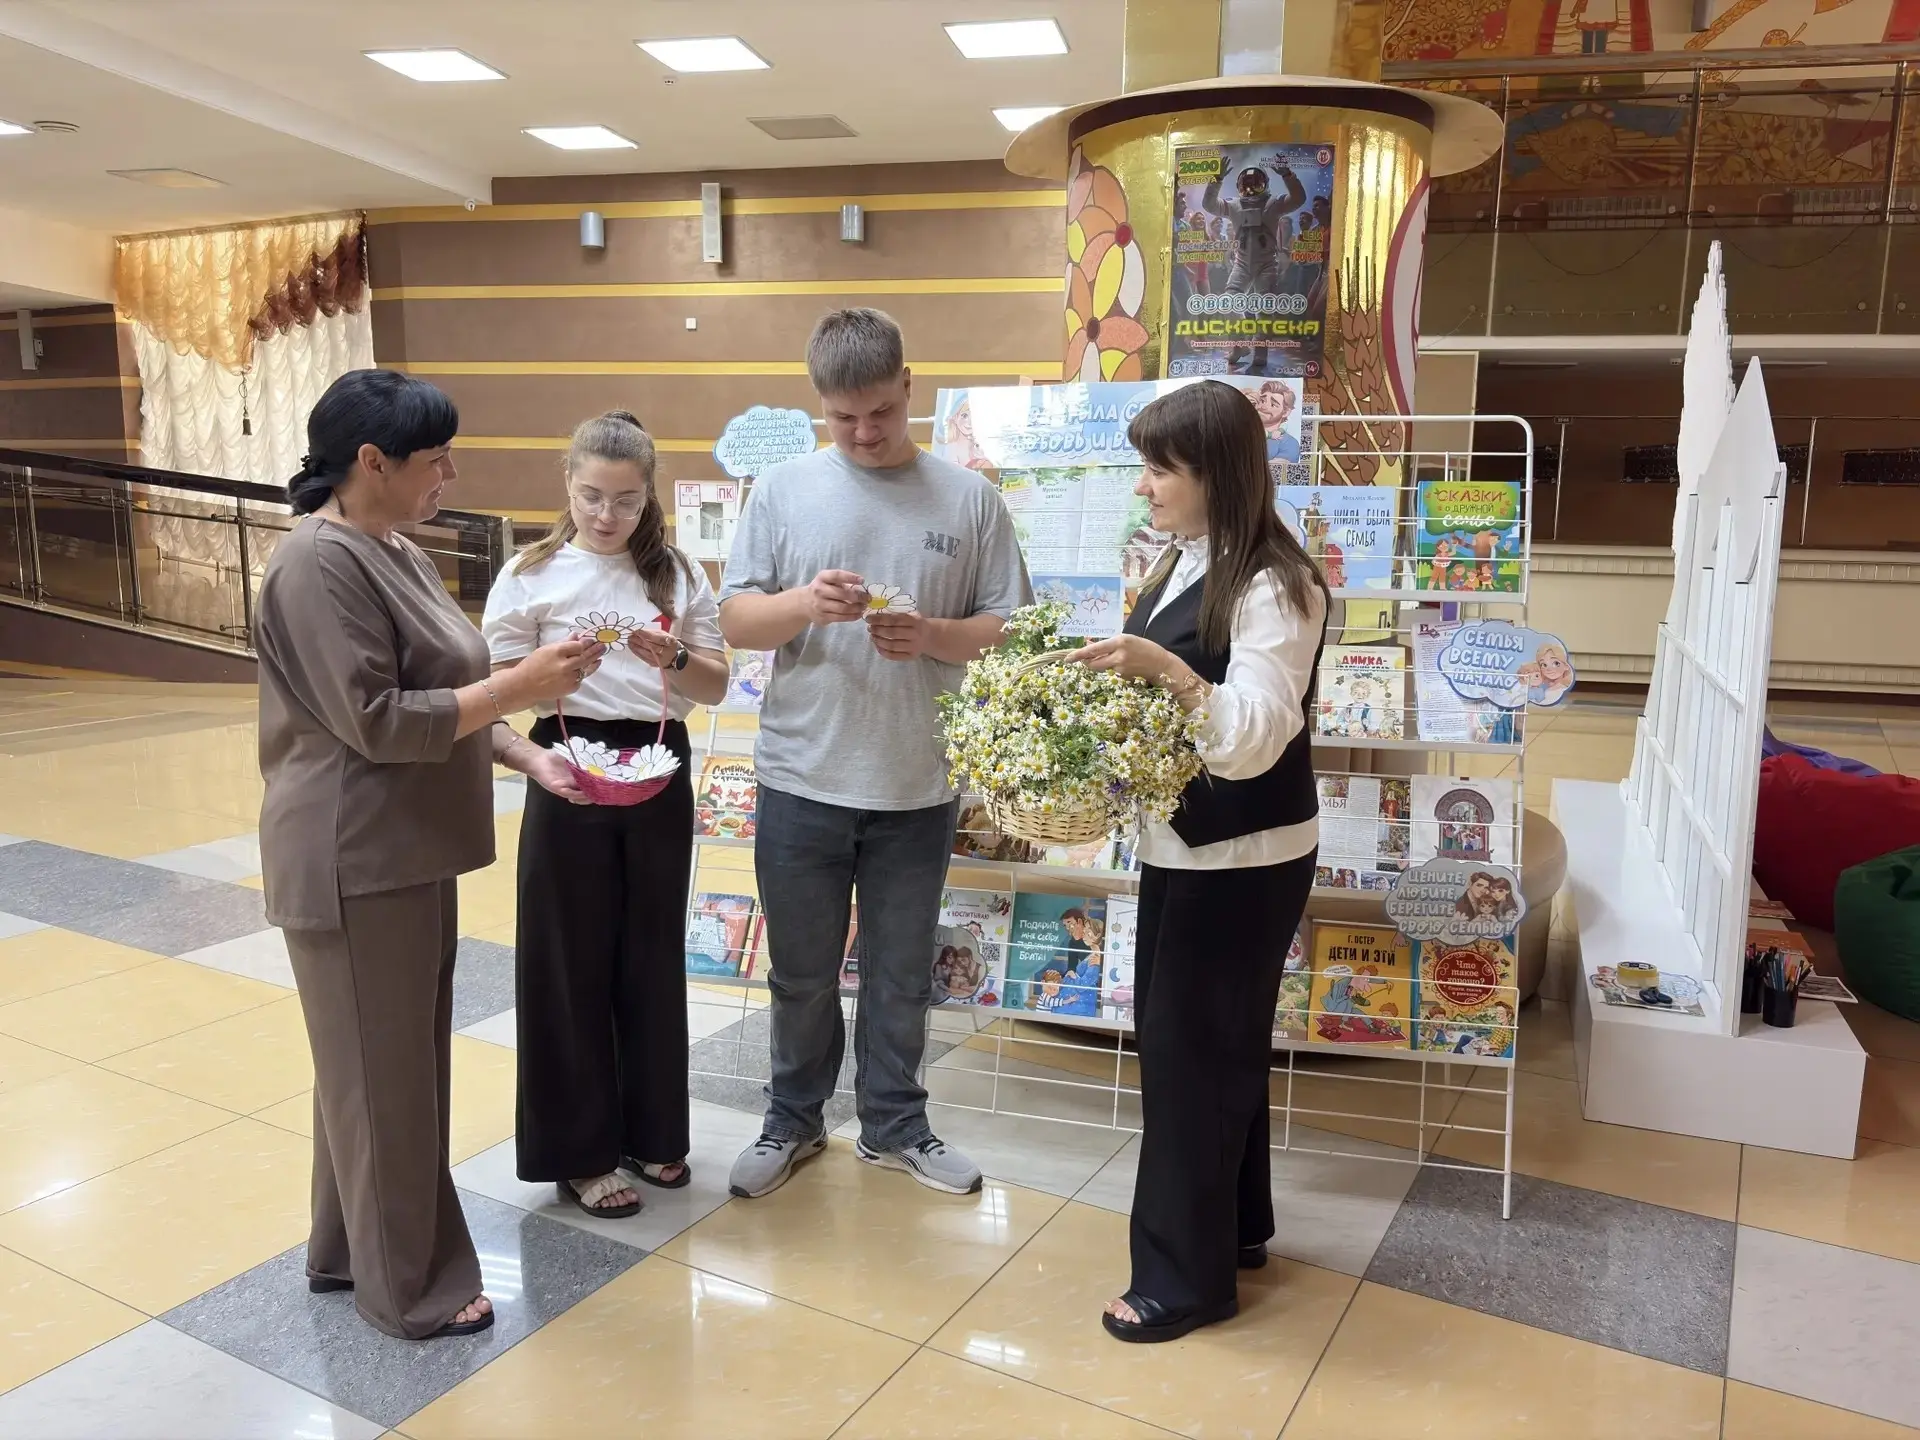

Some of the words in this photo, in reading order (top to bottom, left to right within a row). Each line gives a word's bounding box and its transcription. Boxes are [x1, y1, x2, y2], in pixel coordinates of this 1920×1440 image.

[1180, 148, 1220, 158] ПЯТНИЦА
[1179, 160, 1219, 174] 20:00
[1180, 176, 1217, 185] СУББОТА
[1175, 319, 1320, 336] ДИСКОТЕКА
[718, 487, 733, 500] ПК
[1436, 489, 1504, 502] СКАЗКИ
[1452, 503, 1494, 514] ДРУЖНОЙ
[1333, 509, 1360, 525] ЖИЛА
[1366, 509, 1390, 526] БЫЛА
[1346, 529, 1376, 547] СЕМЬЯ
[1463, 628, 1525, 652] СЕМЬЯ
[1449, 646, 1516, 671] ВСЕМУ
[1452, 668, 1519, 690] НАЧАЛО
[1321, 797, 1348, 809] МЬЯ
[1408, 870, 1466, 886] ЦЕНИТЕ,
[1389, 901, 1456, 917] БЕРЕГИТЕ
[1398, 920, 1445, 934] СВОЮ
[1448, 921, 1512, 936] СЕМЬЮ!
[1347, 935, 1353, 944] Г.
[1355, 935, 1376, 945] ОСТЕР
[1328, 945, 1357, 961] ДЕТИ
[1362, 948, 1370, 962] И
[1374, 949, 1396, 966] ЭТИ
[1456, 959, 1477, 969] Что
[1451, 969, 1480, 977] такое
